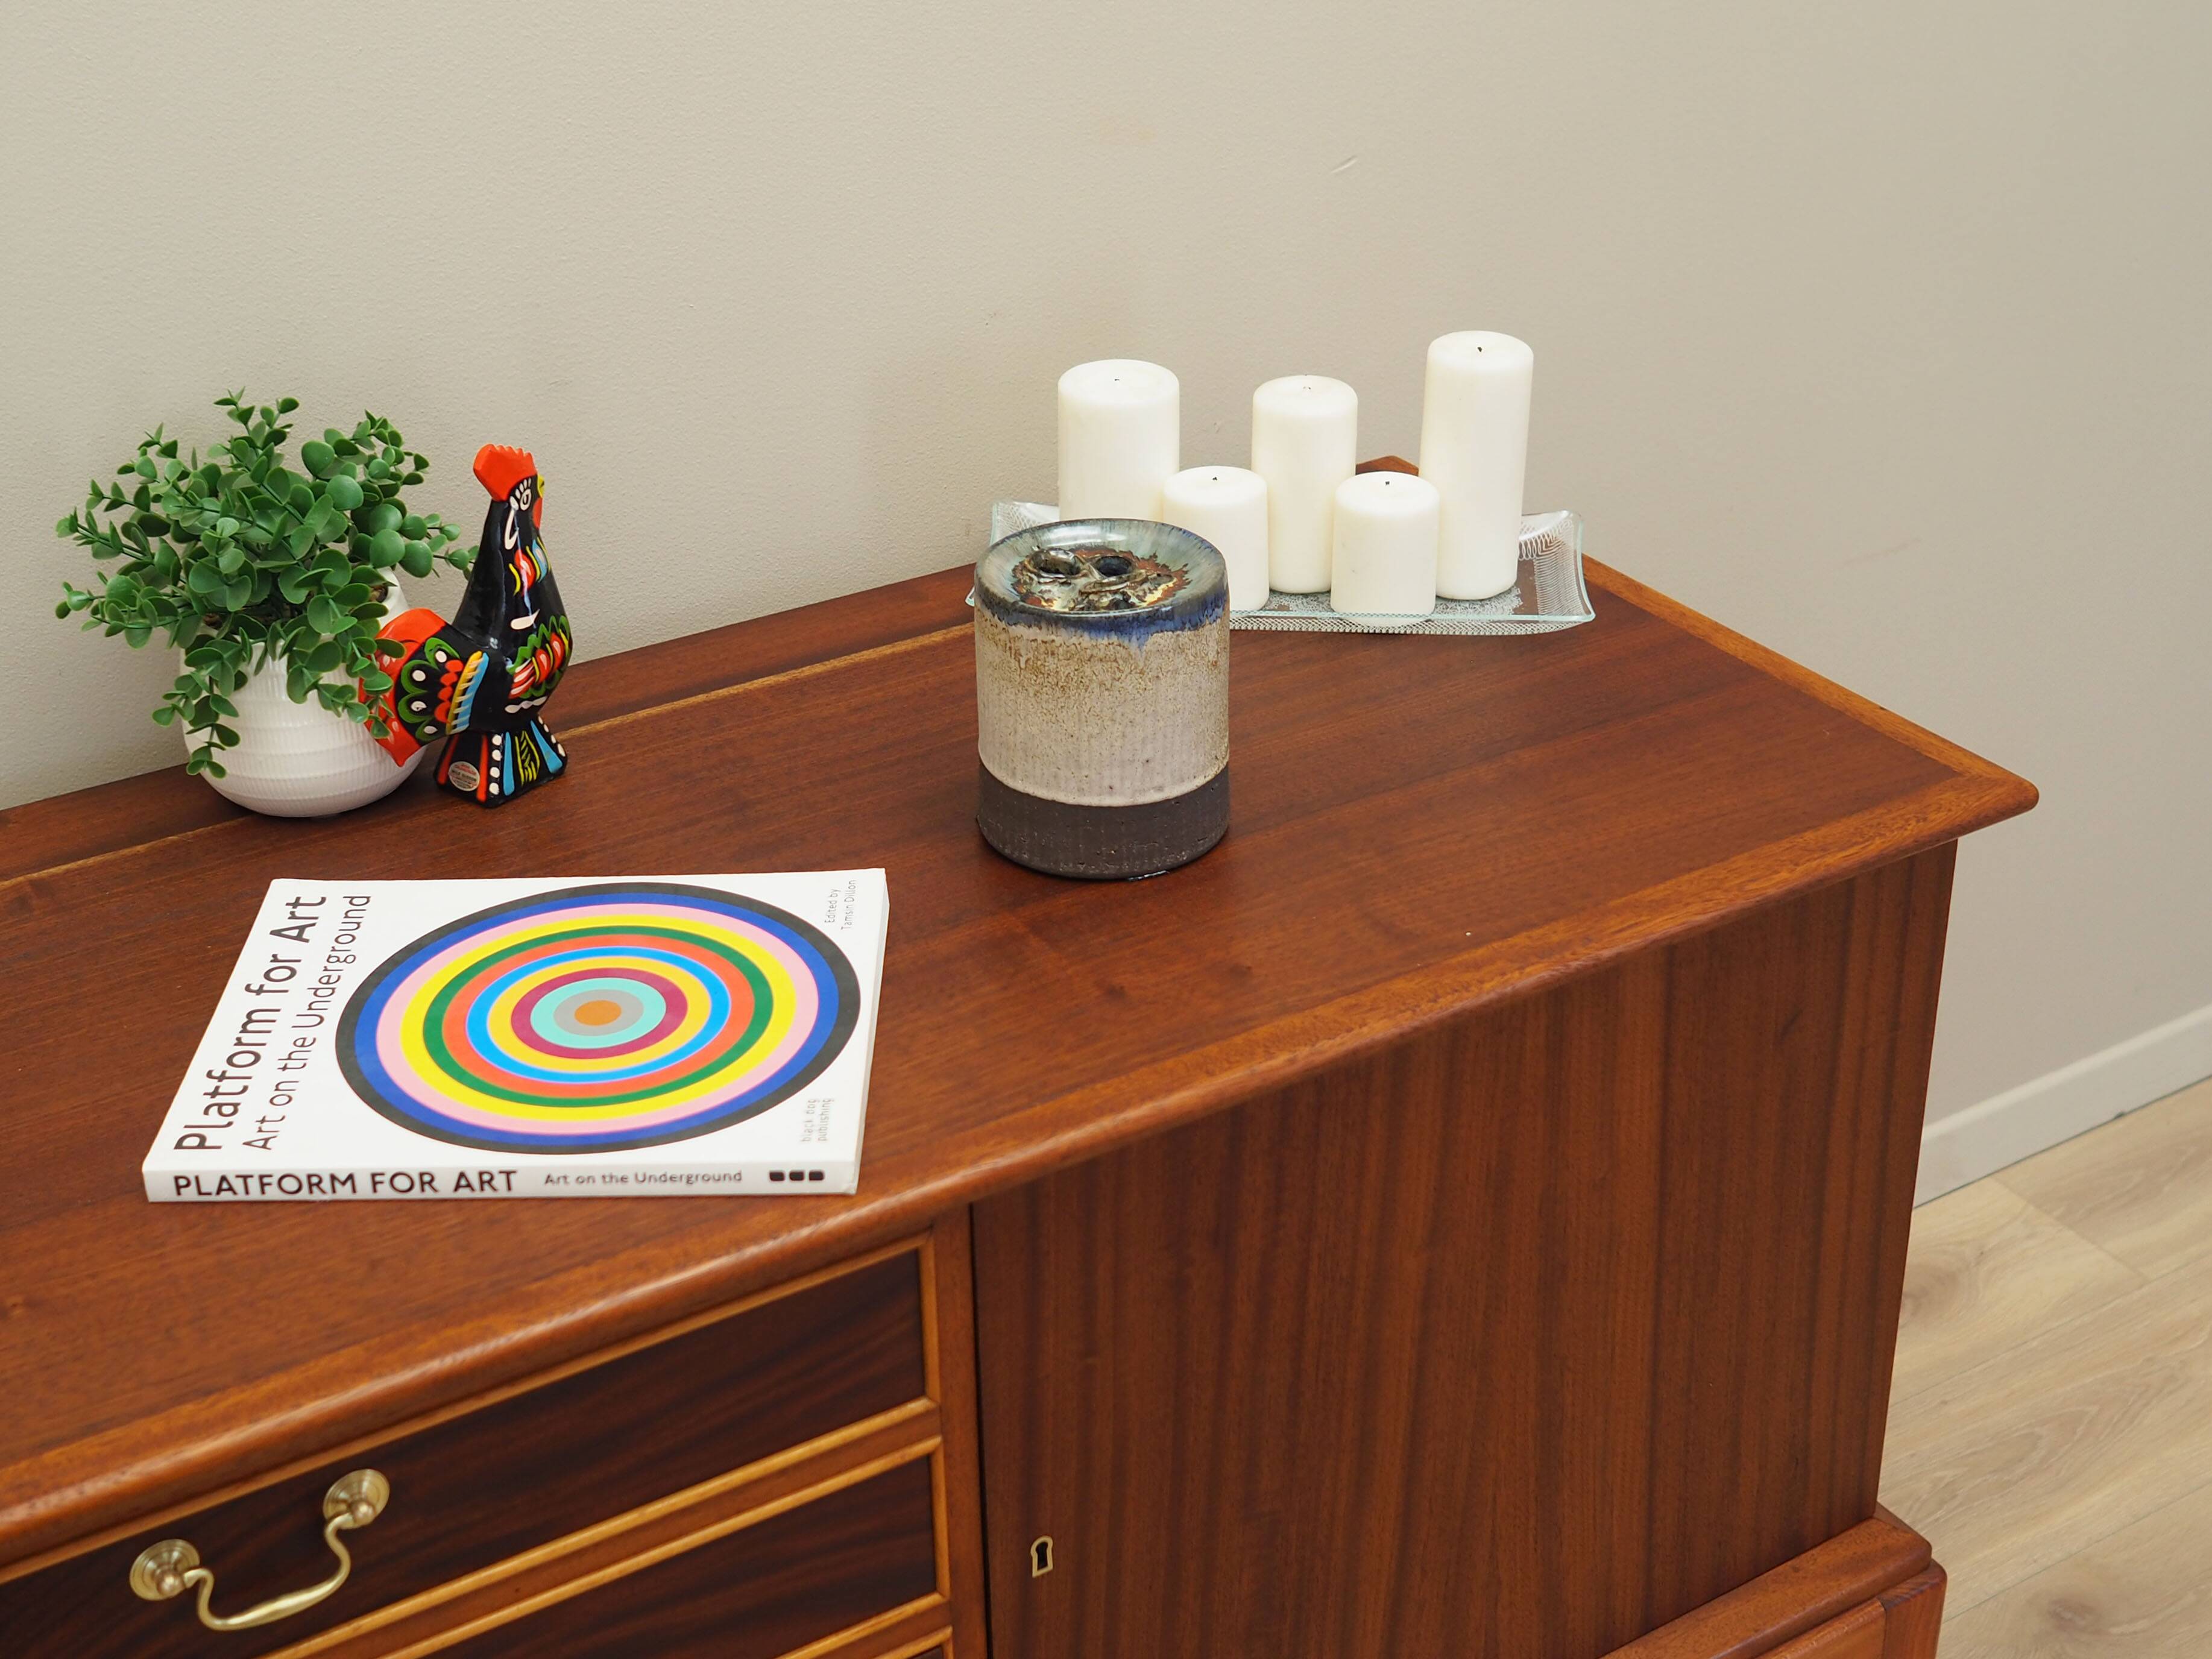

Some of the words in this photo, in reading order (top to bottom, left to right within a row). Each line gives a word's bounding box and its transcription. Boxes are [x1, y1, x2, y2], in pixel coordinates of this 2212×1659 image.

[828, 889, 841, 898] by
[844, 879, 857, 902] Dillon
[269, 896, 327, 943] Art
[824, 900, 837, 924] Edited
[840, 904, 854, 930] Tamsin
[244, 954, 302, 996] for
[291, 895, 372, 1028] Underground
[277, 1037, 317, 1072] the
[174, 1008, 281, 1150] Platform
[269, 1080, 300, 1106] on
[242, 1115, 286, 1150] Art
[818, 1098, 835, 1142] publishing
[174, 1173, 358, 1196] PLATFORM
[370, 1171, 439, 1194] FOR
[452, 1170, 518, 1193] ART
[544, 1173, 570, 1185] Art
[575, 1175, 596, 1185] on
[602, 1172, 629, 1184] the
[634, 1169, 743, 1185] Underground
